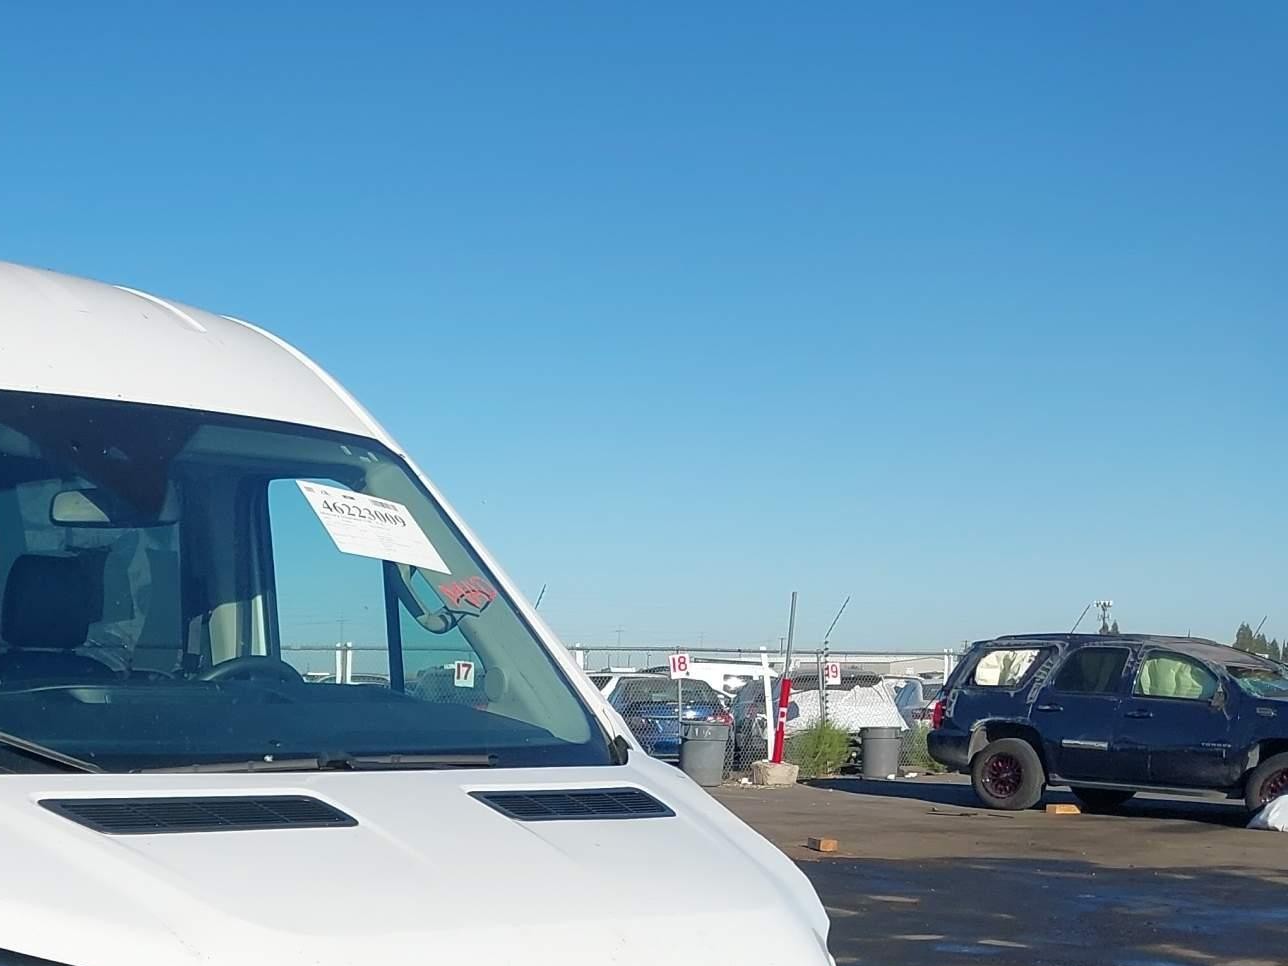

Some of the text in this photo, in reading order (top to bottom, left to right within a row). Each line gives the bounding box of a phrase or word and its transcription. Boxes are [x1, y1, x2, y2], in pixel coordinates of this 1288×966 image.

[322, 499, 407, 527] 46223009
[456, 662, 473, 681] 17
[671, 655, 688, 673] 18
